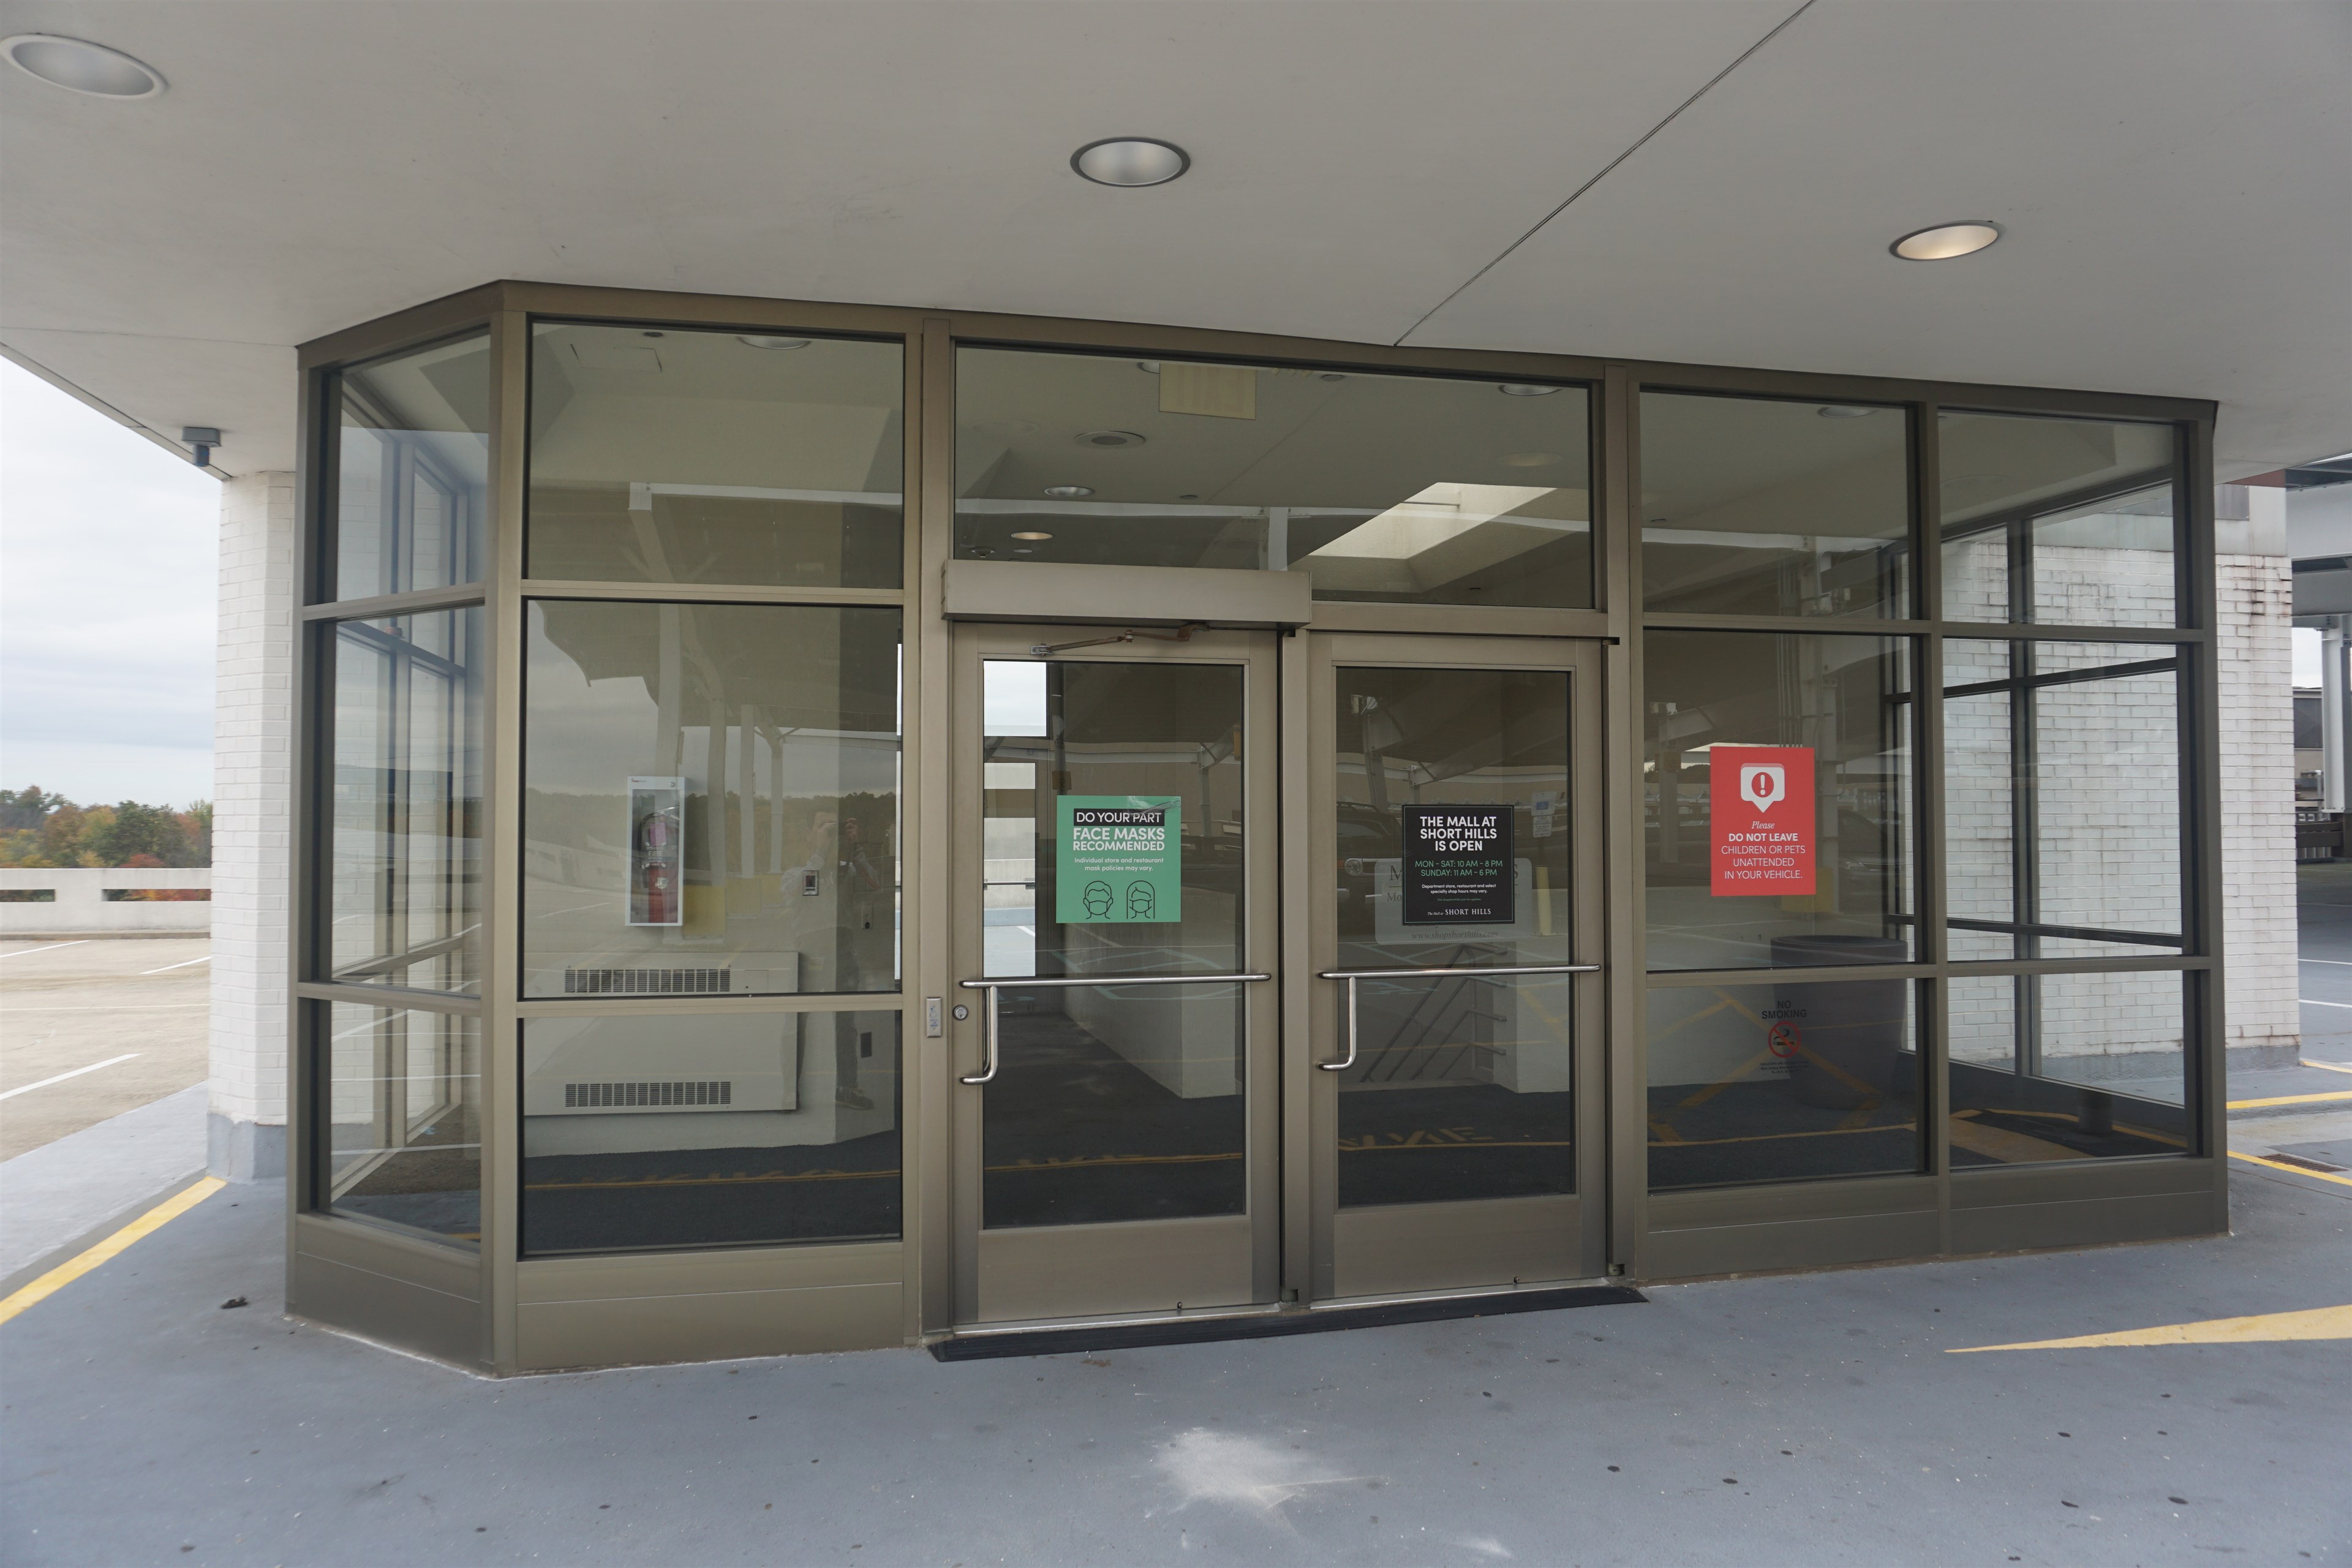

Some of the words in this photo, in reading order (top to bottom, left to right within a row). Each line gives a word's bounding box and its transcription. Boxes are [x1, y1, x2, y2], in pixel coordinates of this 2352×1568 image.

[1076, 812, 1095, 823] DO
[1096, 812, 1130, 823] YOUR
[1133, 812, 1161, 823] PART
[1420, 816, 1444, 827] THE
[1447, 816, 1480, 827] MALL
[1482, 816, 1496, 827] AT
[1751, 821, 1774, 829] Please
[1074, 827, 1110, 840] FACE
[1114, 827, 1165, 840] MASKS
[1420, 829, 1462, 839] SHORT
[1465, 829, 1497, 839] HILLS
[1728, 833, 1743, 842] DO
[1746, 833, 1766, 842] NOT
[1073, 841, 1164, 851] RECOMMENDED
[1435, 841, 1446, 851] IS
[1449, 840, 1482, 851] OPEN
[1721, 845, 1766, 854] CHILDREN
[1769, 845, 1782, 854] OR
[1785, 845, 1806, 854] PETS
[1733, 858, 1794, 867] UNATTENDED
[1725, 871, 1734, 880] IN
[1736, 870, 1762, 879] YOUR
[1764, 870, 1803, 878] VEHICLE.
[1411, 930, 1498, 940] www.shopshorthills.com
[1777, 1000, 1792, 1009] NO
[1762, 1009, 1807, 1019] SMOKING
